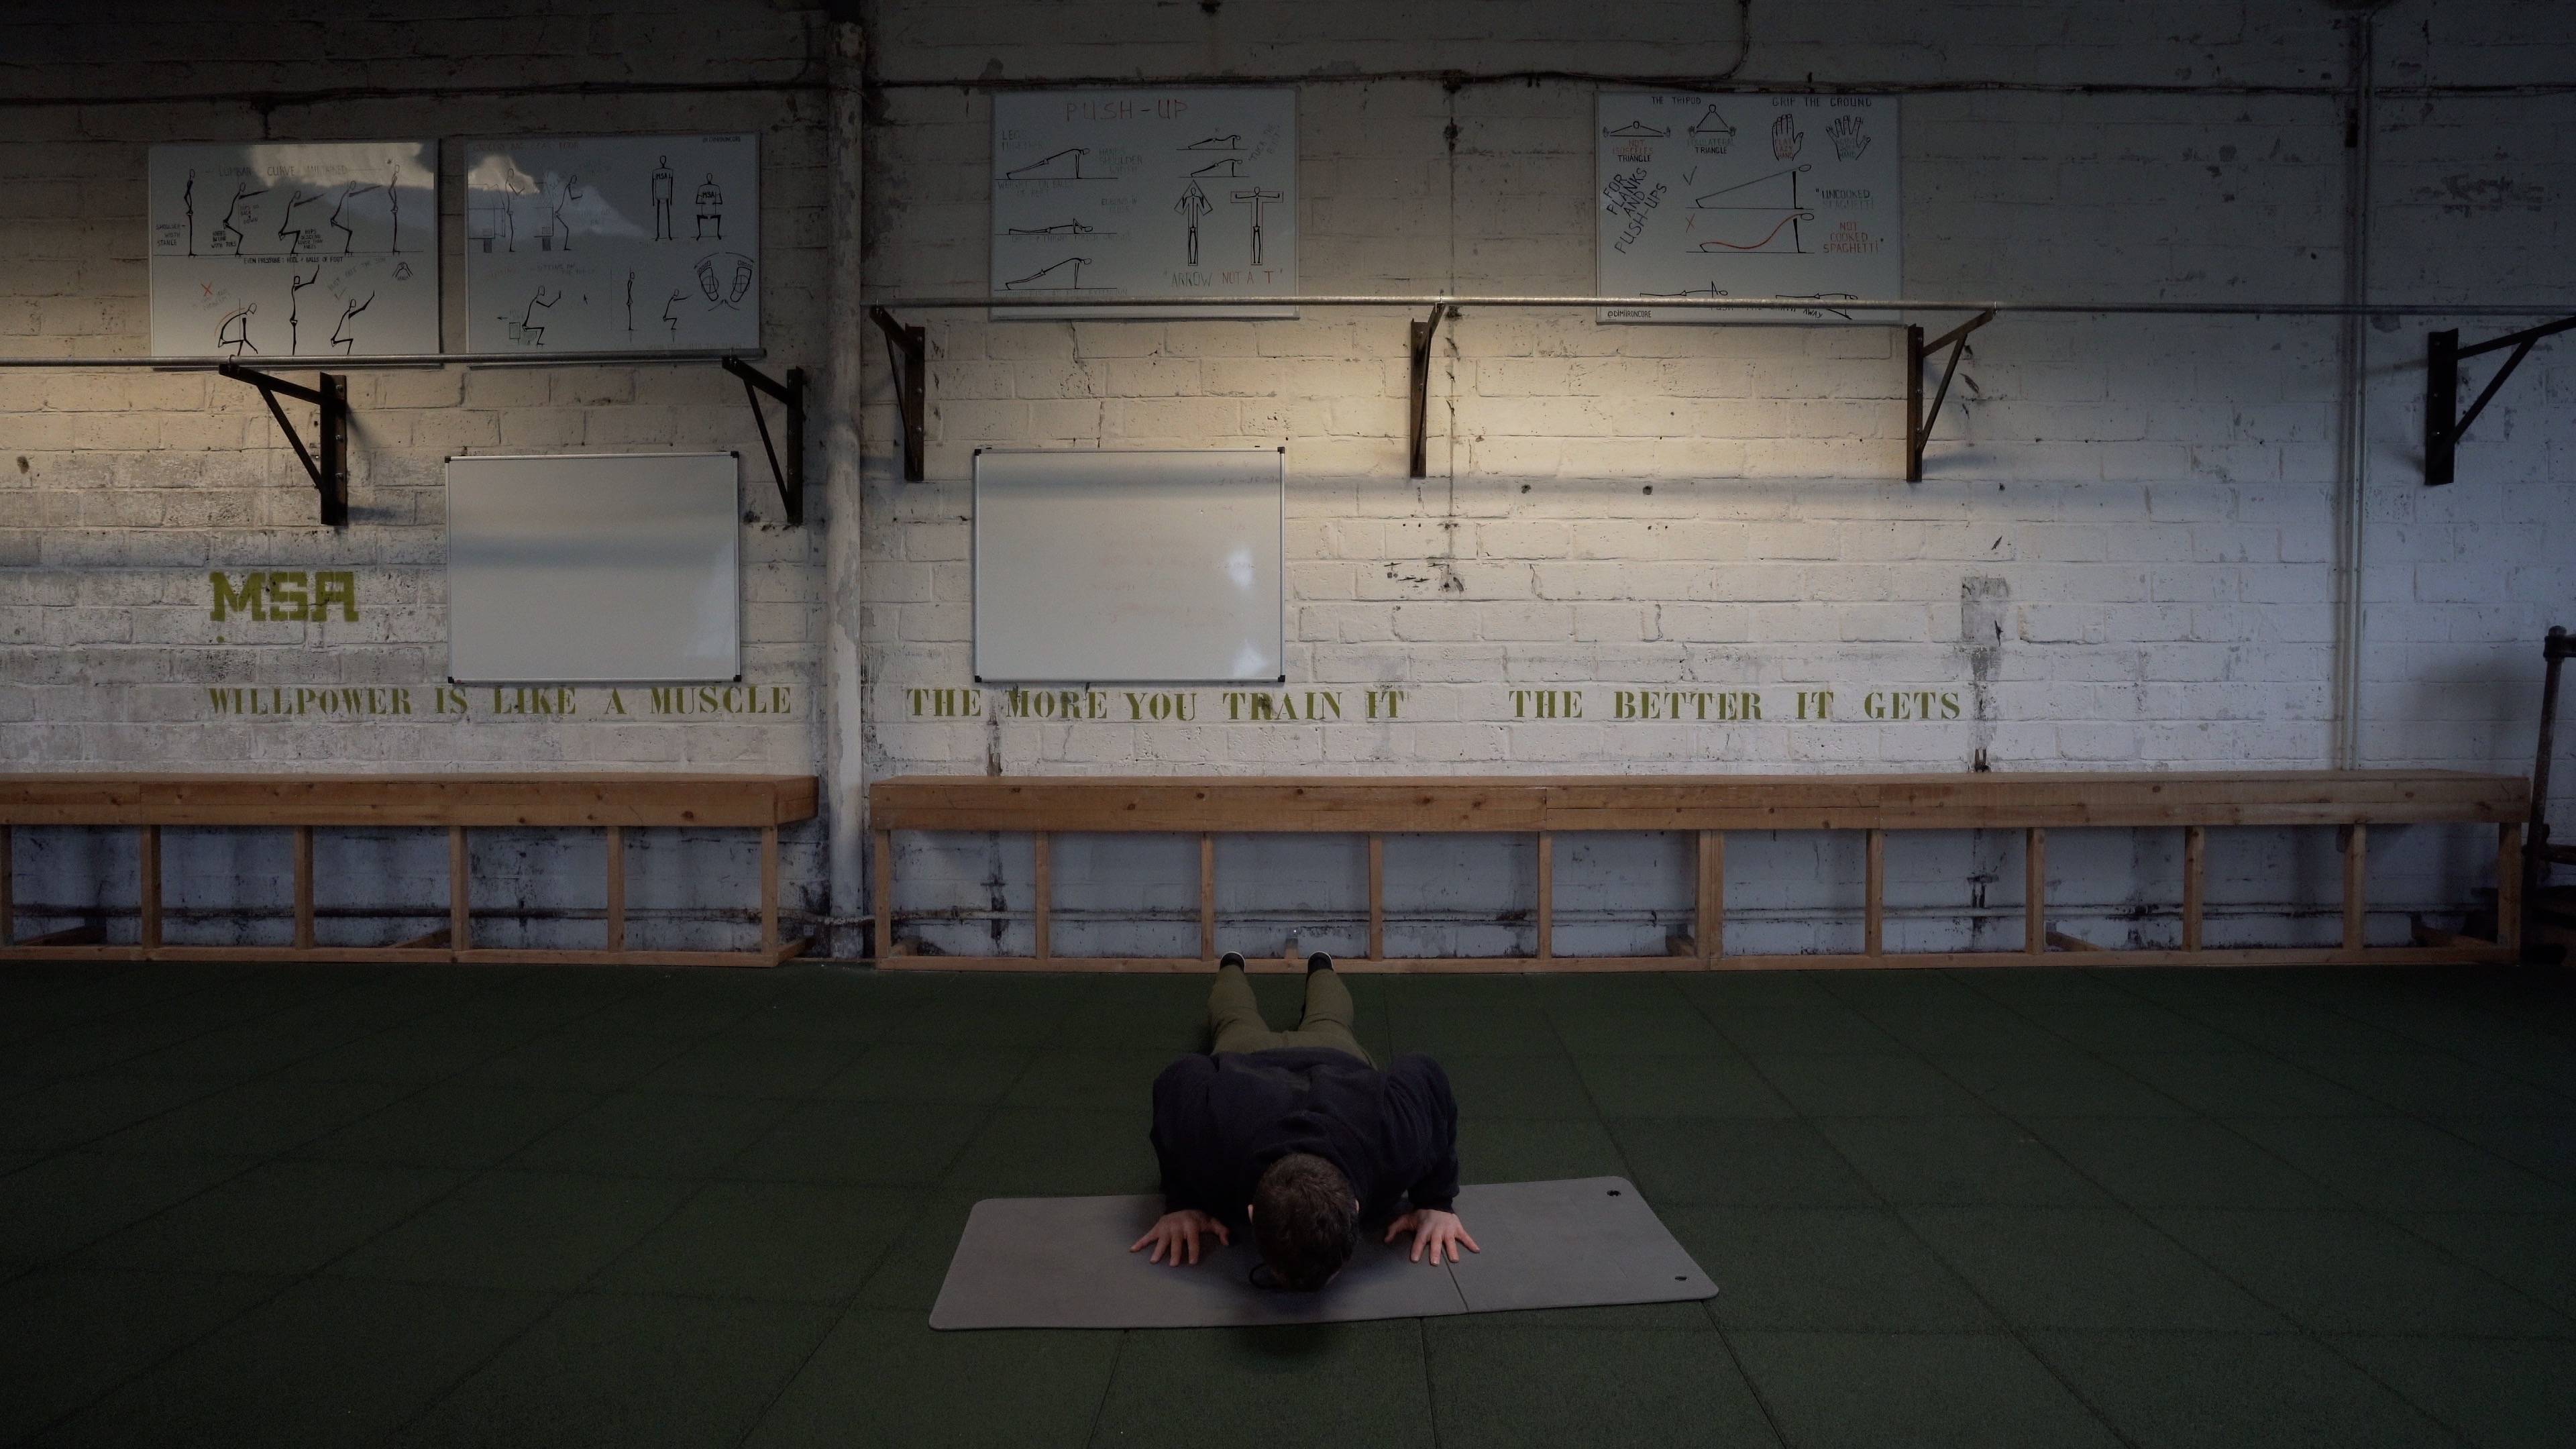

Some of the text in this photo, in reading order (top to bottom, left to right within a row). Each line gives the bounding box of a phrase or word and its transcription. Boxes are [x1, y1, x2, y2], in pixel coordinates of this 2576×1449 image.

[1066, 99, 1187, 122] PUSH-UP
[1772, 97, 1872, 107] GRIP THE GROUND
[267, 166, 294, 176] CURVE
[1603, 174, 1627, 199] FOR
[1607, 167, 1647, 215] PLANKS
[1623, 191, 1645, 218] AND
[1615, 183, 1667, 254] PUSH-UPS
[1839, 222, 1858, 231] NOT
[1830, 232, 1868, 241] COOKED
[1222, 272, 1242, 284] NOT
[1247, 272, 1254, 284] A
[210, 572, 359, 622] MSA
[209, 687, 1960, 721] WILLPOWER IS LIKE A MUSCLE THE MORE YOU TRAIN IT THE BETTER IT GETS
